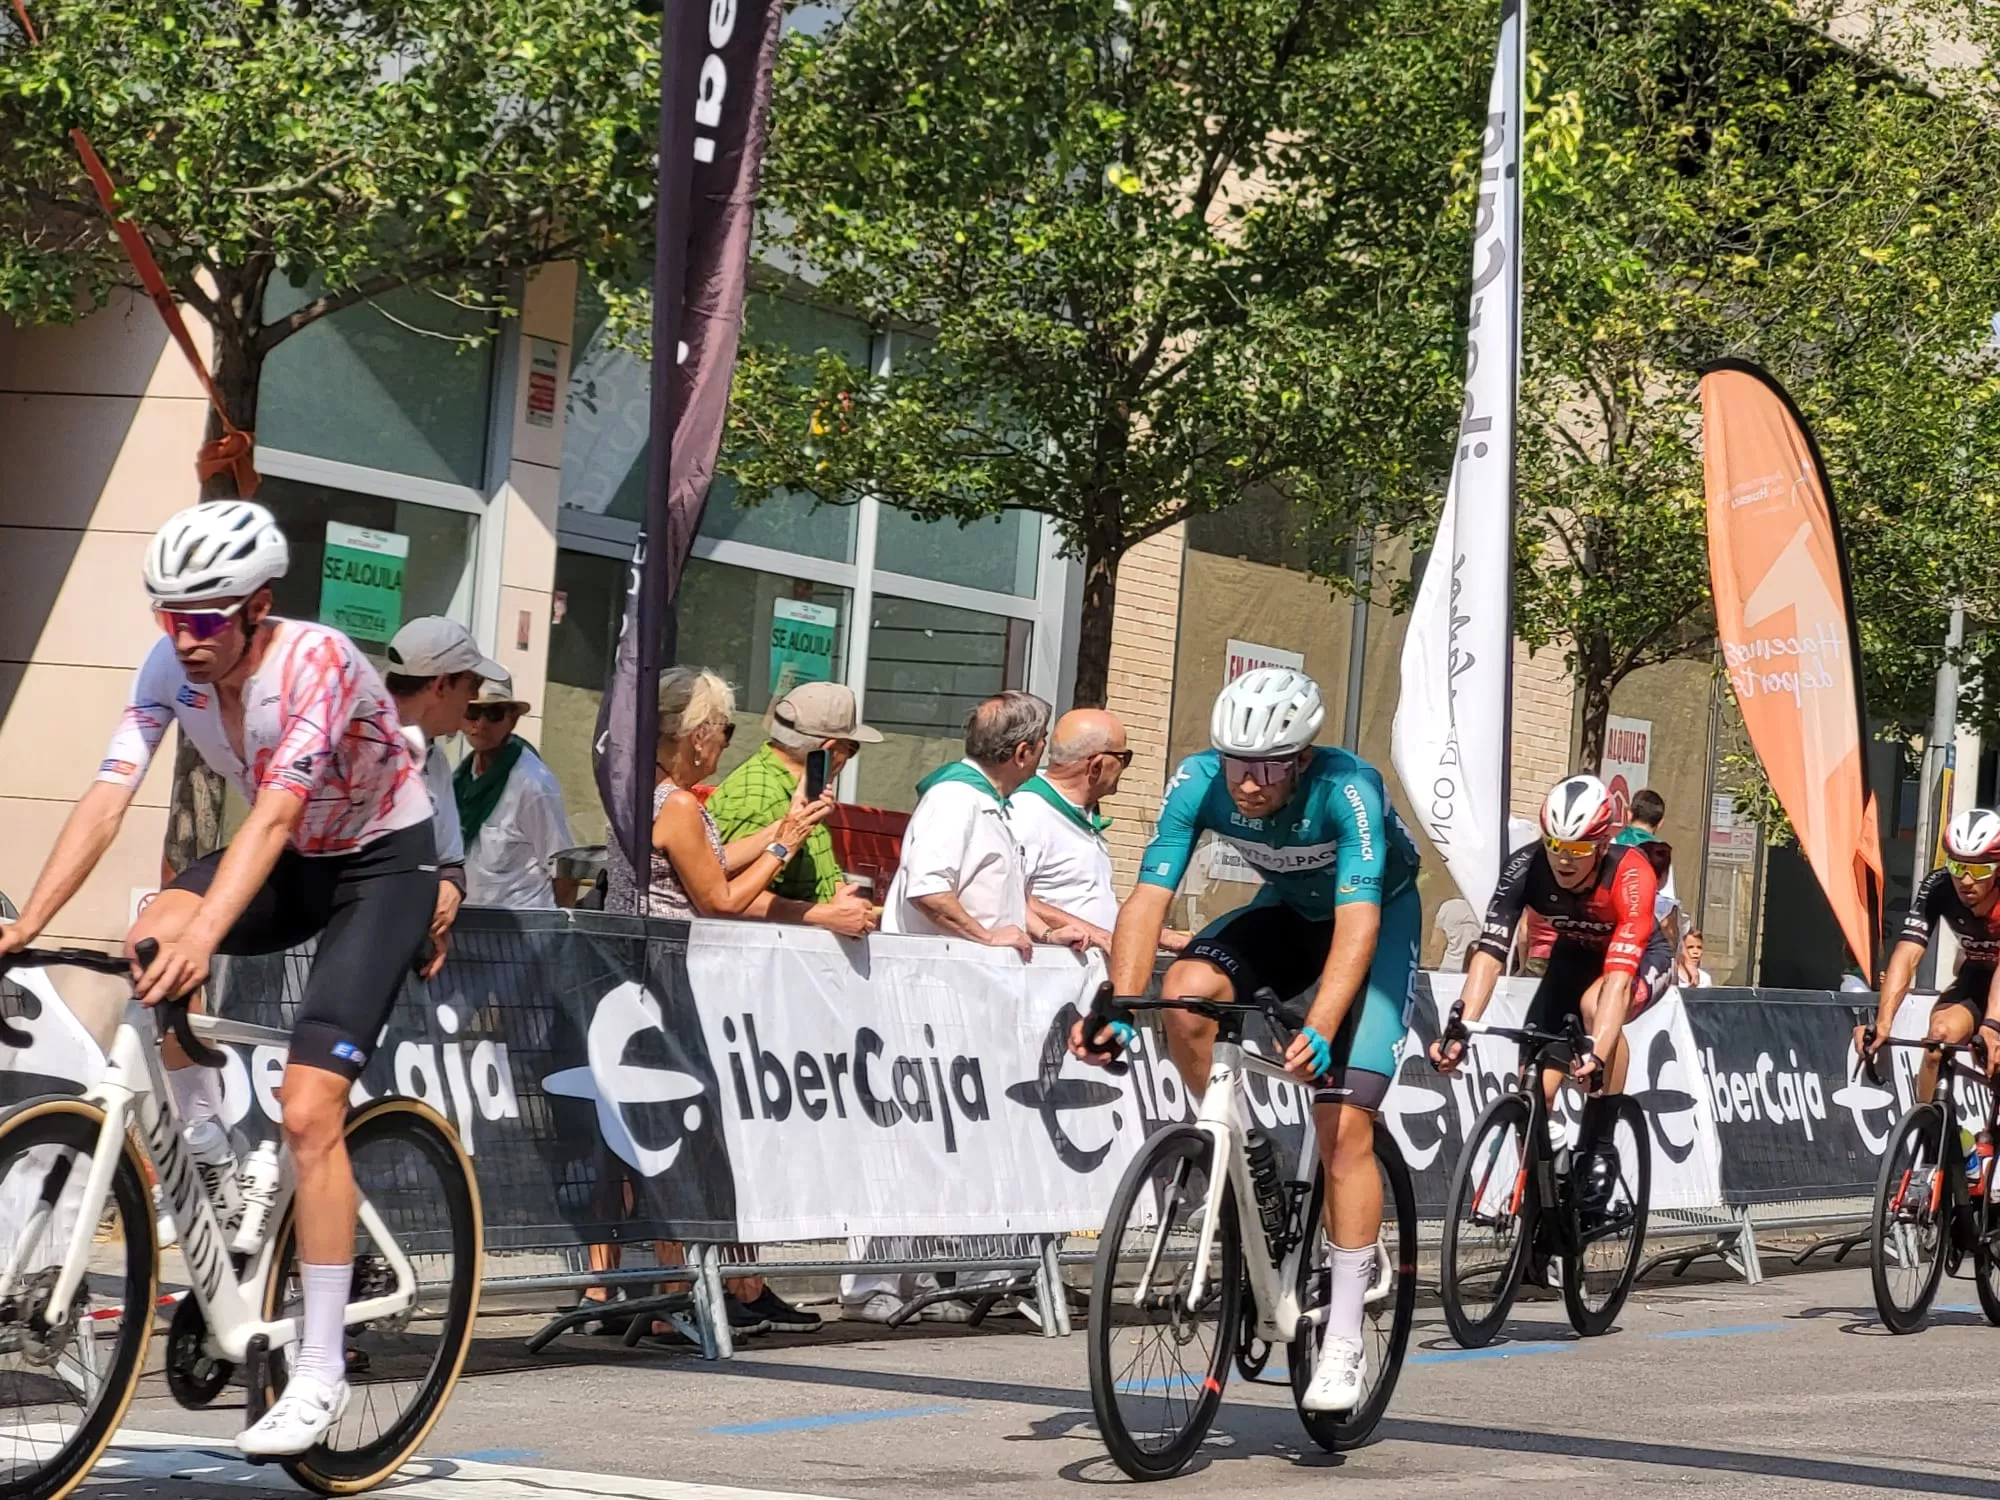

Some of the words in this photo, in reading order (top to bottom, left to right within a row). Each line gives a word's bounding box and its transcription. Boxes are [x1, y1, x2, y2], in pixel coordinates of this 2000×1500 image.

[323, 556, 345, 581] SE
[343, 561, 401, 591] ALQUILA
[771, 628, 787, 650] SE
[788, 631, 831, 657] ALQUILA
[1607, 728, 1647, 765] ALQUILER
[1342, 784, 1376, 862] CONTROLPACK
[722, 1011, 989, 1153] iberCaja
[1697, 1047, 1827, 1141] iberCaja
[150, 1101, 225, 1305] CANYON
